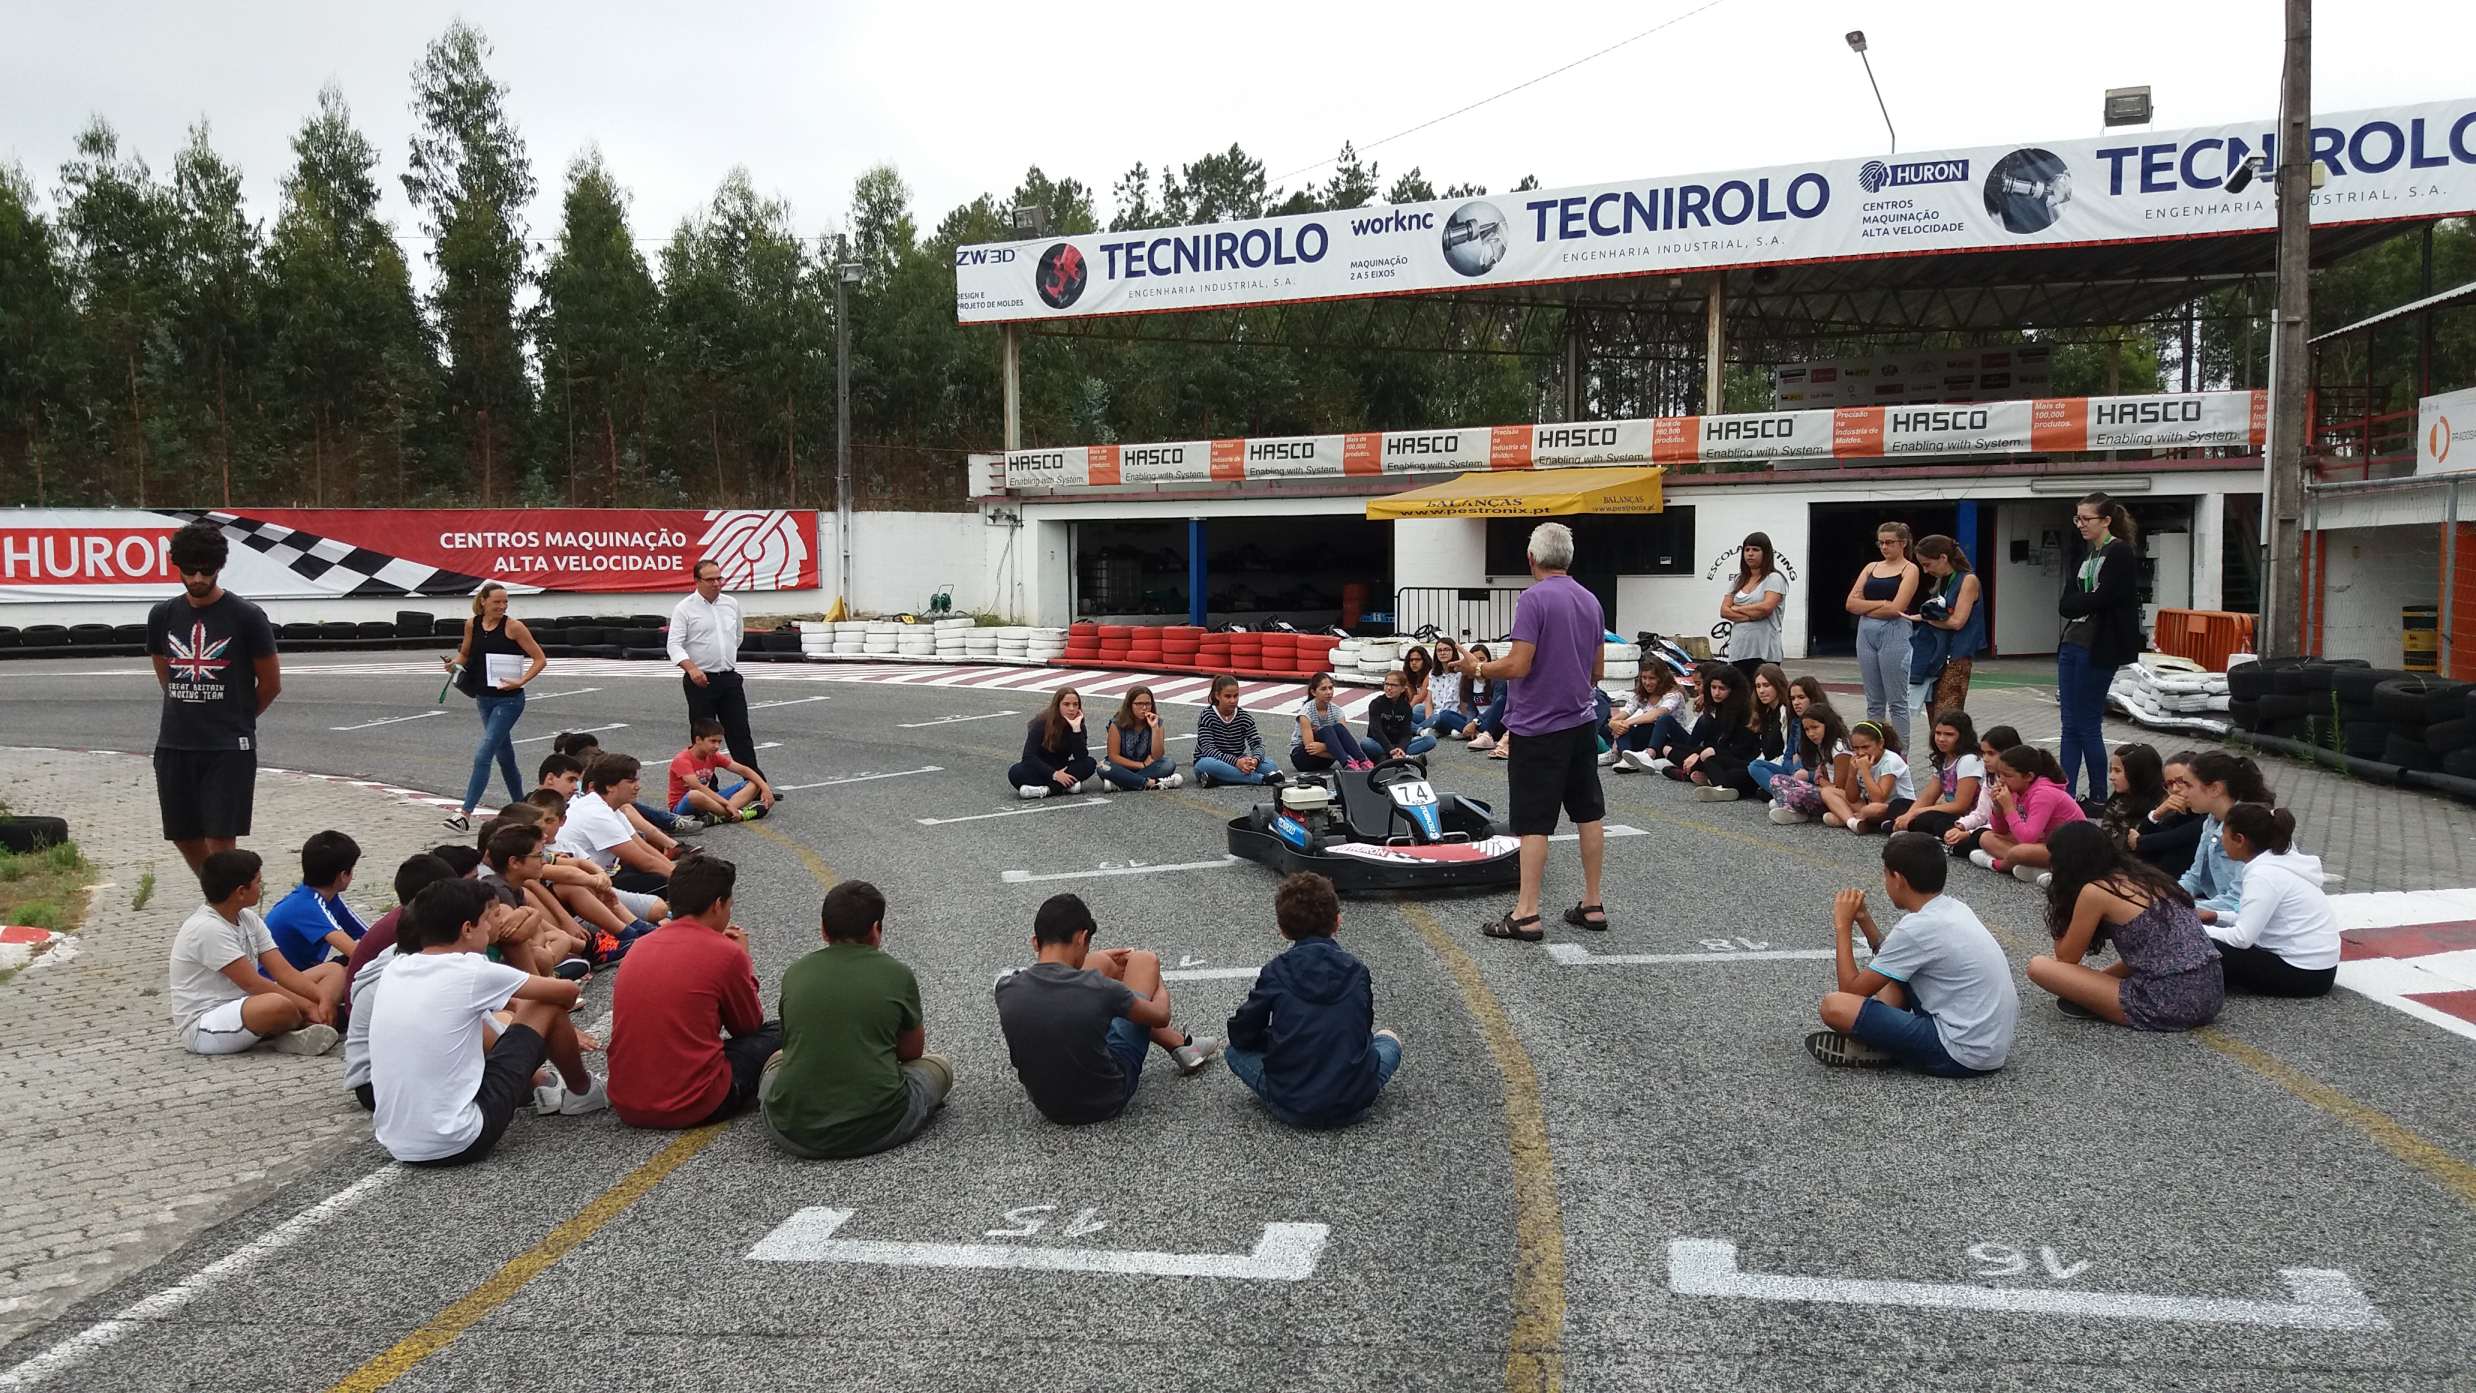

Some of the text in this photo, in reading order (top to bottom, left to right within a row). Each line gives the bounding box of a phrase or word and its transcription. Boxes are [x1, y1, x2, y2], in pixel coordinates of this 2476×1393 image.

[1897, 163, 1963, 183] HURON
[1526, 172, 1831, 242] TECNIROLO
[1862, 199, 1914, 212] CENTROS
[2144, 200, 2264, 220] ENGENHARIA
[2408, 184, 2448, 199] S.A.
[1350, 209, 1434, 236] worknc
[1862, 209, 1940, 225] MAQUINAÇÃO
[1861, 222, 1965, 238] ALTA VELOCIDADE
[956, 249, 1016, 266] ZW3D
[1100, 223, 1329, 280] TECNIROLO
[1563, 235, 1785, 263] ENGENHARIA INDUSTRIAL, S.A.
[1350, 255, 1408, 269] MAQUINAÇÃO
[1357, 272, 1363, 280] A
[1364, 271, 1369, 279] 5
[1371, 269, 1396, 278] EIXOS
[981, 291, 985, 299] E
[1128, 277, 1296, 299] ENGENHARIA INDUSTRIAL, S.A.
[987, 301, 996, 309] DE
[997, 299, 1024, 308] MOLDES
[2034, 402, 2054, 410] Mais
[2096, 401, 2201, 424] HASCO
[1706, 418, 1794, 441] HASCO
[1892, 410, 1988, 432] HASCO
[1387, 436, 1459, 455] HASCO
[1538, 427, 1617, 448] HASCO
[1892, 438, 2025, 452] Enabling with System.
[2096, 430, 2241, 446] Enabling with System.
[1125, 448, 1183, 466] HASCO
[1250, 443, 1315, 461] HASCO
[1539, 455, 1581, 466] Enabling
[1583, 454, 1604, 463] with
[1706, 448, 1753, 459] Enabling
[1755, 447, 1778, 457] with
[1009, 454, 1064, 471] HASCO
[1387, 461, 1427, 472] Enabling
[1428, 460, 1446, 470] with
[1125, 471, 1156, 482] Enabling
[1250, 467, 1286, 477] Enabling
[1287, 466, 1303, 475] with
[1009, 476, 1040, 487] Enabling
[1400, 506, 1551, 516] www.pestronix.pt
[440, 528, 688, 551] CENTROS MAQUINAÇÃO
[493, 555, 683, 572] ALTA VELOCIDADE
[203, 691, 224, 700] TEAM
[1699, 937, 1769, 950] 18
[984, 1204, 1115, 1237] 15
[1965, 1241, 2096, 1279] 16
